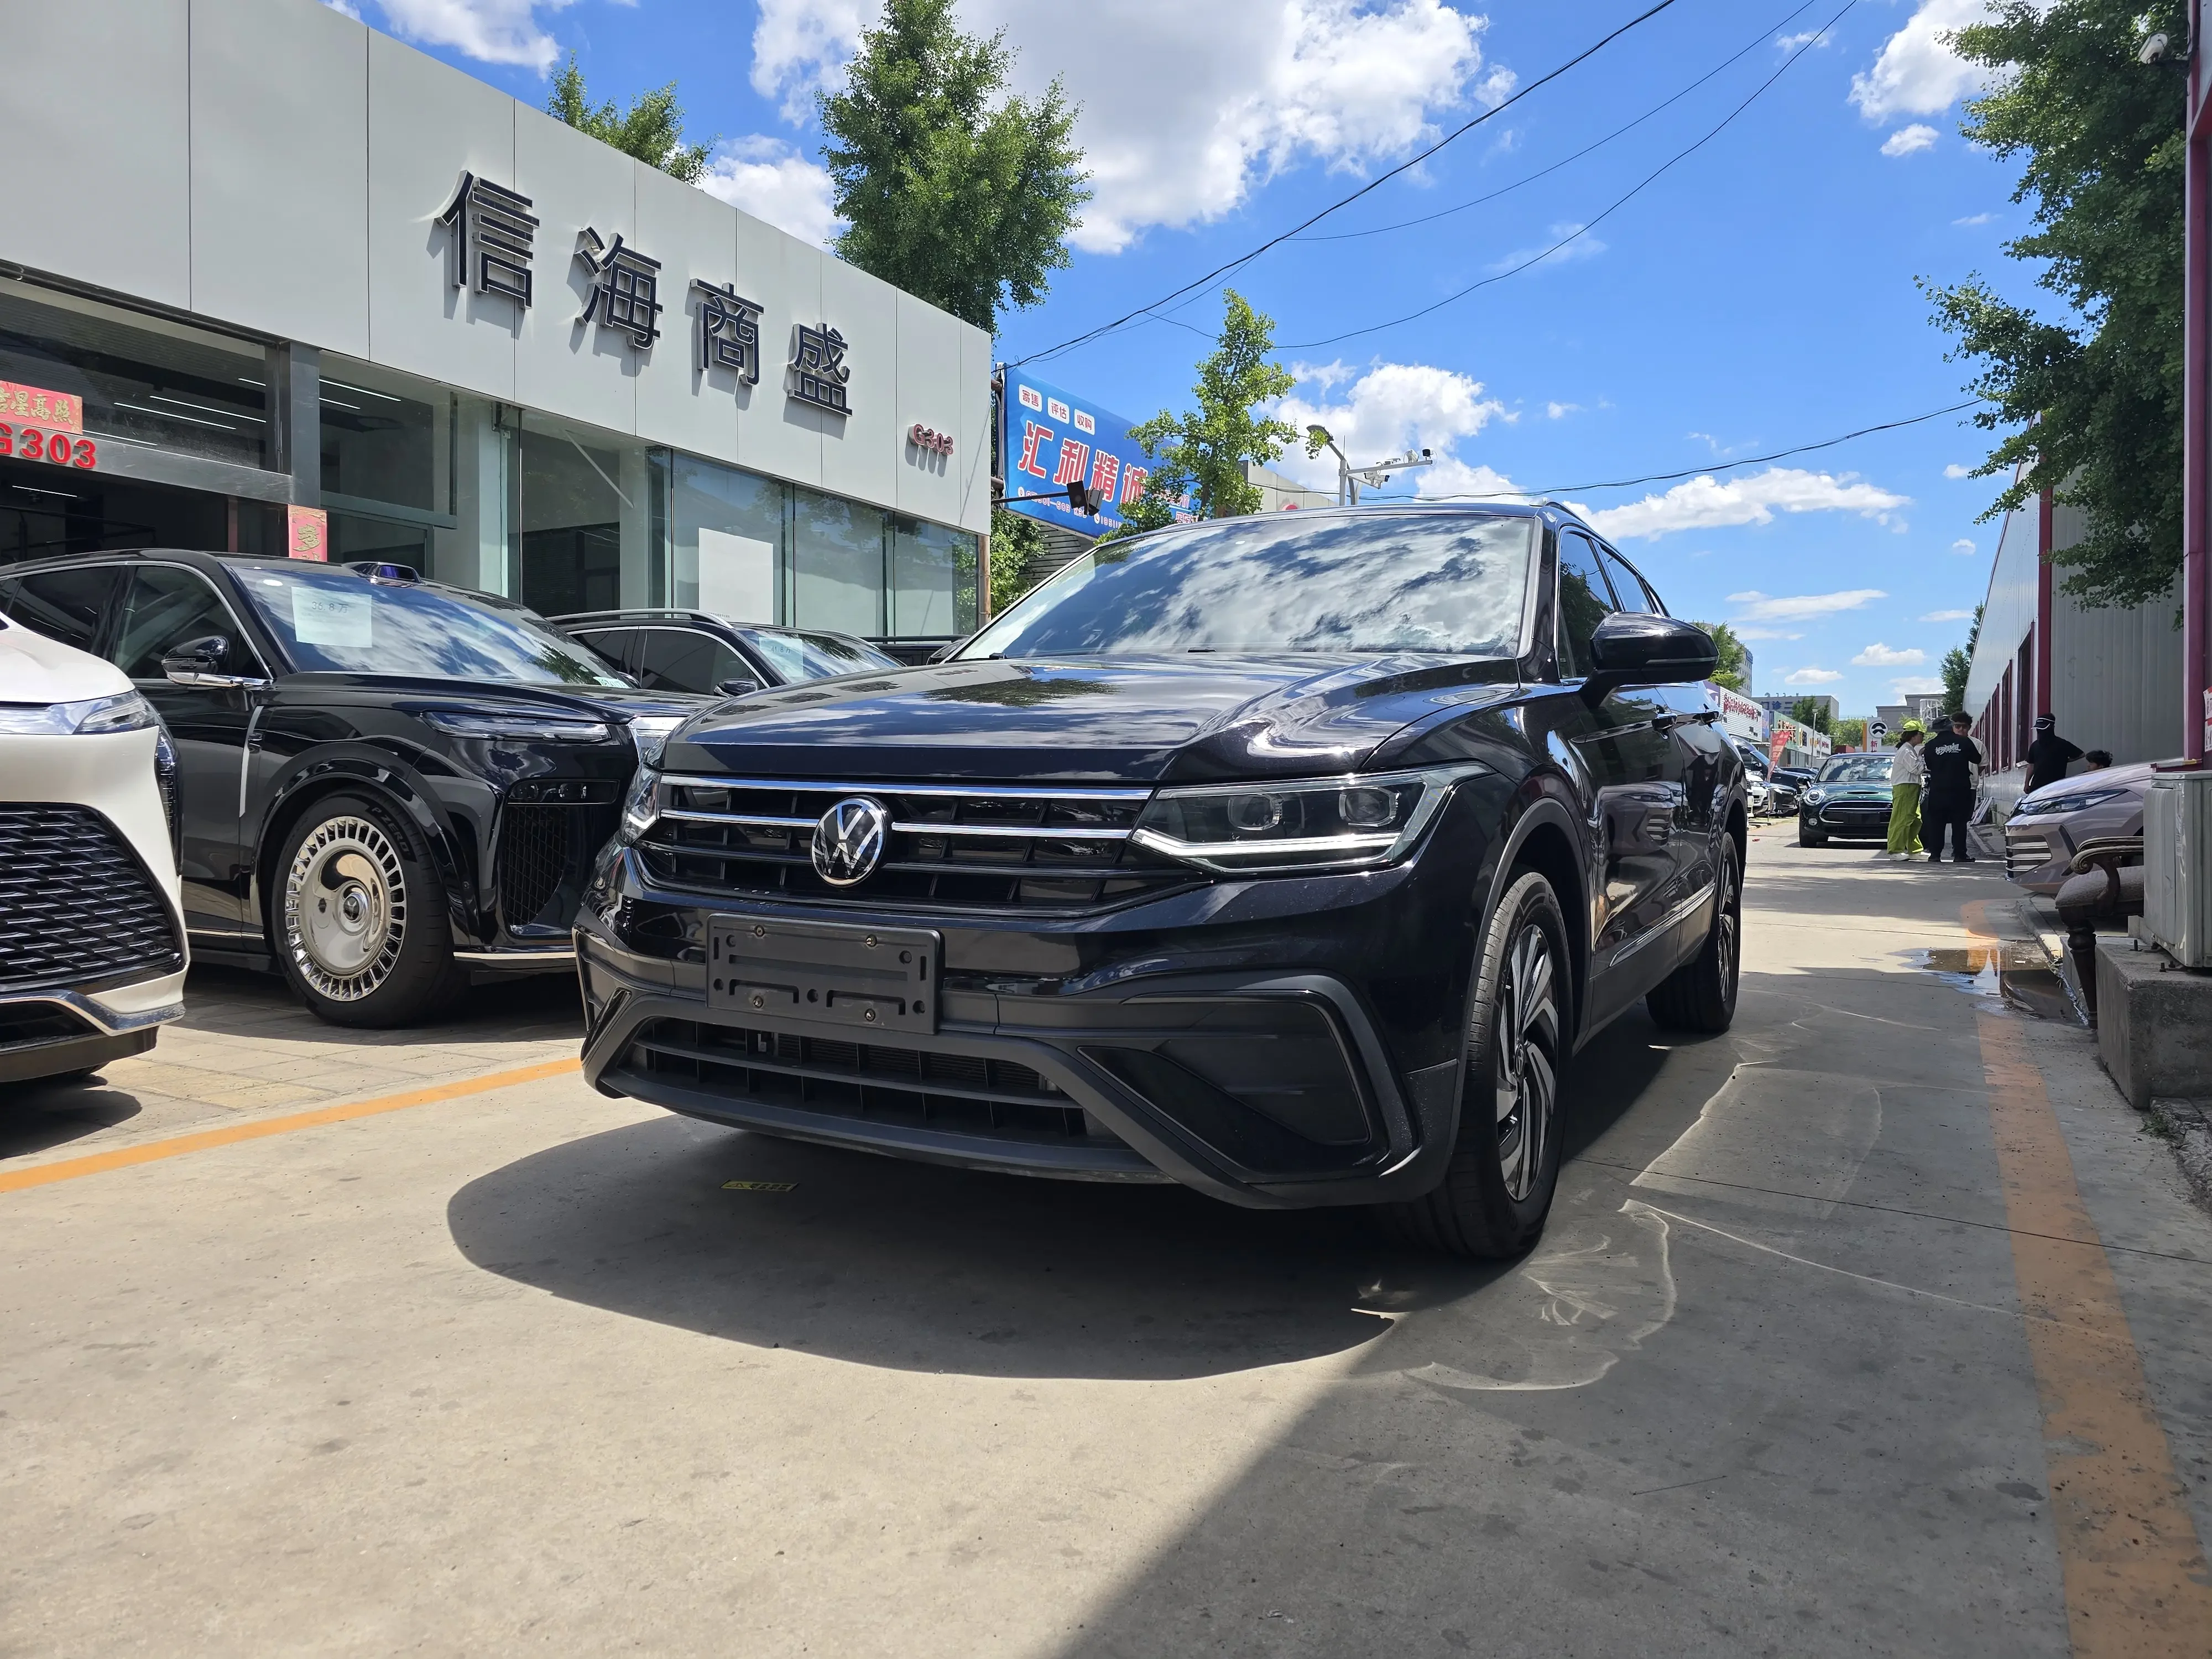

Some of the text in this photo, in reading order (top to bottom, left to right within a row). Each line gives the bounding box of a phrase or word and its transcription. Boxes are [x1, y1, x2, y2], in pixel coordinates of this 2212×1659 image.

[434, 170, 852, 416] 信海商盛
[910, 423, 953, 455] G303
[1022, 389, 1092, 430] 寄售 评估 收购
[1018, 420, 1148, 504] 汇利精诚
